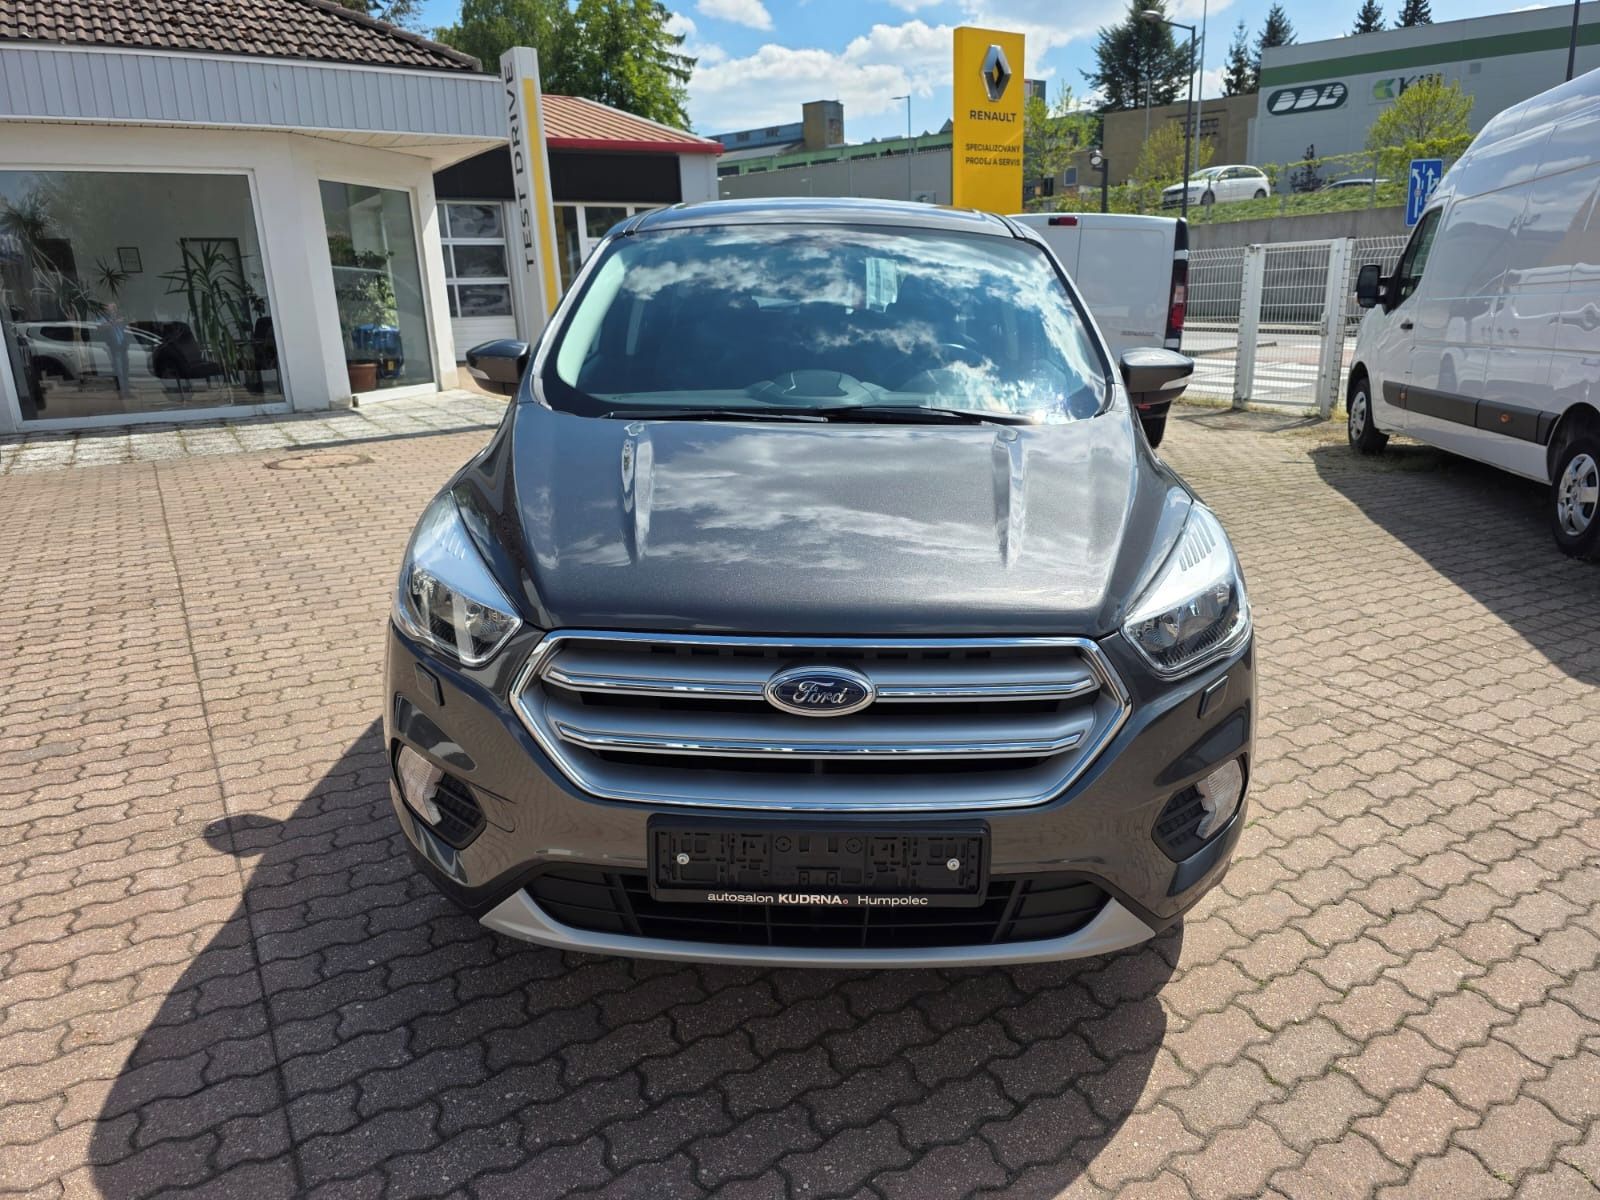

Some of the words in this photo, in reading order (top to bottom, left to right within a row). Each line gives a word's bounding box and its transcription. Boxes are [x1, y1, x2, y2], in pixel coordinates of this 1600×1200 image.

[504, 61, 525, 176] DRIVE
[970, 110, 1017, 122] RENAULT
[965, 156, 992, 166] PRODEJ
[998, 157, 1020, 166] SERVIS
[516, 188, 536, 273] TEST
[792, 680, 848, 704] Ford
[707, 892, 774, 904] autosalon
[857, 895, 929, 907] Humpolec
